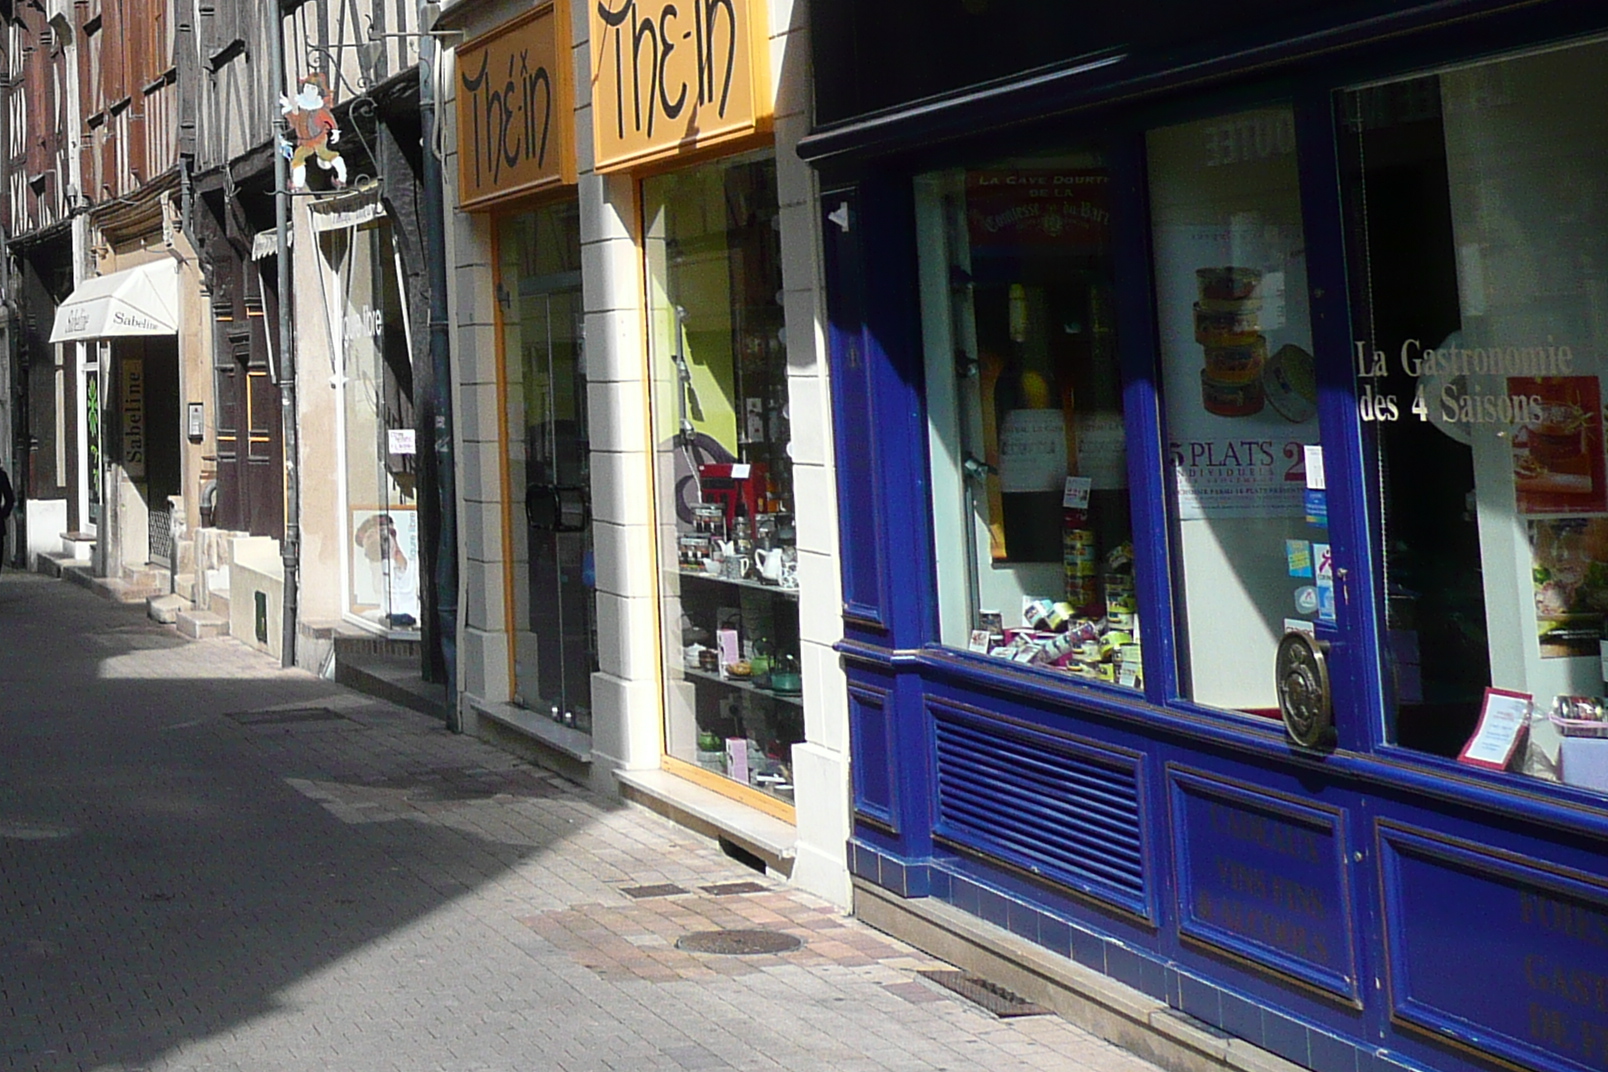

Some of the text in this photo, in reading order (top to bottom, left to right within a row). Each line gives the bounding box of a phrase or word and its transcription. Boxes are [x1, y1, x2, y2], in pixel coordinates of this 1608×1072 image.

[112, 311, 159, 331] Sabeline
[1354, 334, 1573, 378] La Gastronomie
[125, 371, 142, 464] Sabeline
[1359, 384, 1542, 424] des 4 Saisons
[1189, 441, 1275, 467] PLATS
[1282, 441, 1307, 482] 2
